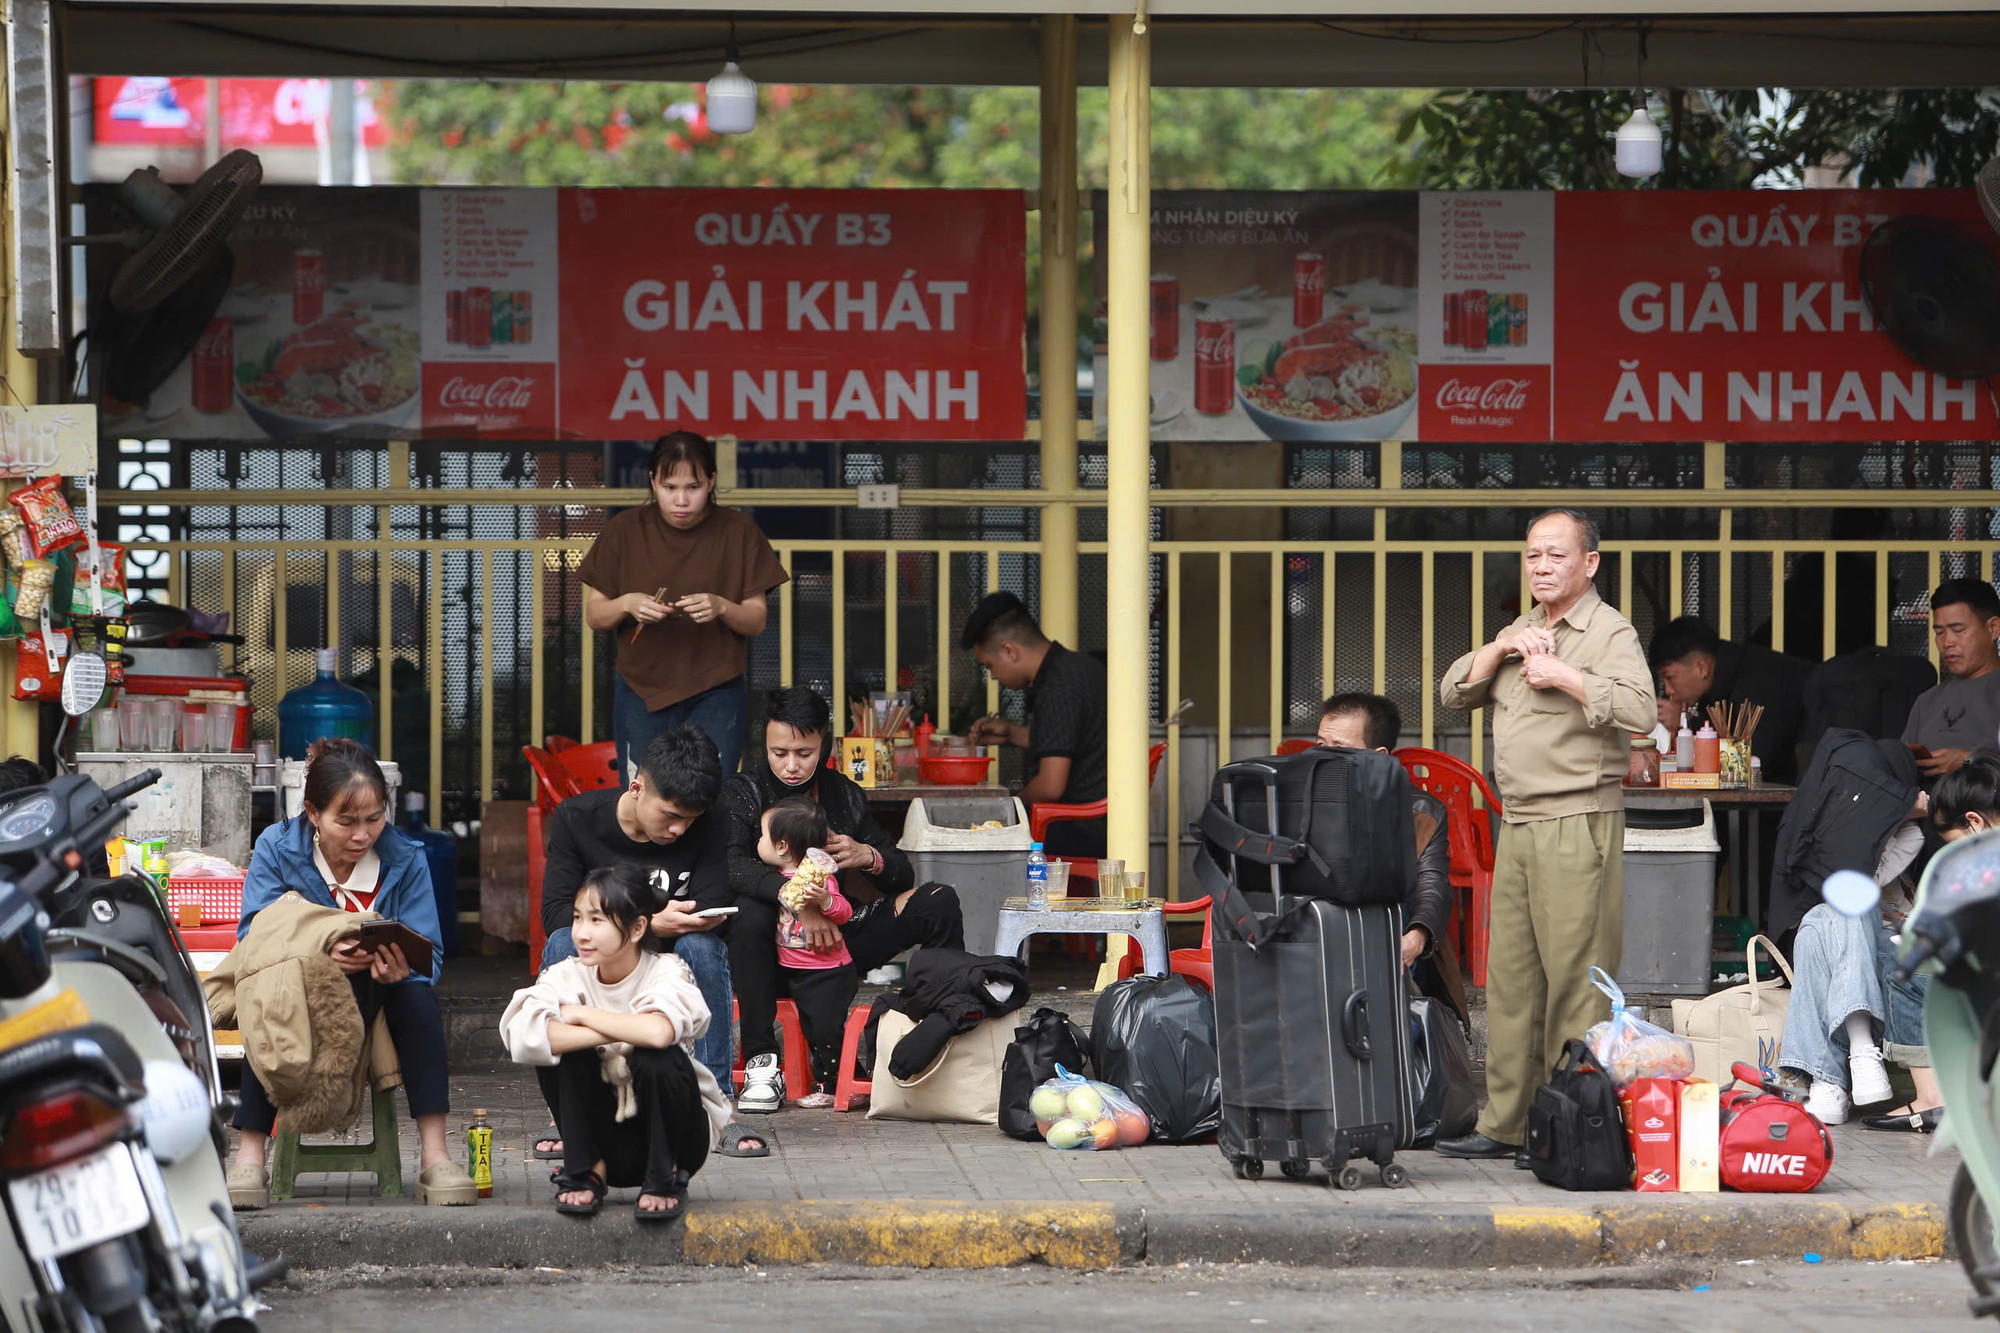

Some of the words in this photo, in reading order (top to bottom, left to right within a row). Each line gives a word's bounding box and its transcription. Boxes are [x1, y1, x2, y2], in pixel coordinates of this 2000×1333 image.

[695, 203, 822, 246] QUẦY
[836, 214, 892, 245] B3
[1692, 204, 1819, 247] QUẦY
[623, 264, 763, 332] GIẢI
[786, 268, 969, 331] KHÁT
[1619, 266, 1758, 333] GIẢI
[609, 357, 710, 421] ĂN
[733, 370, 980, 421] NHANH
[1603, 359, 1703, 422] ĂN
[1727, 370, 1977, 422] NHANH
[479, 1133, 488, 1166] TEA
[1741, 1151, 1807, 1176] NIKE
